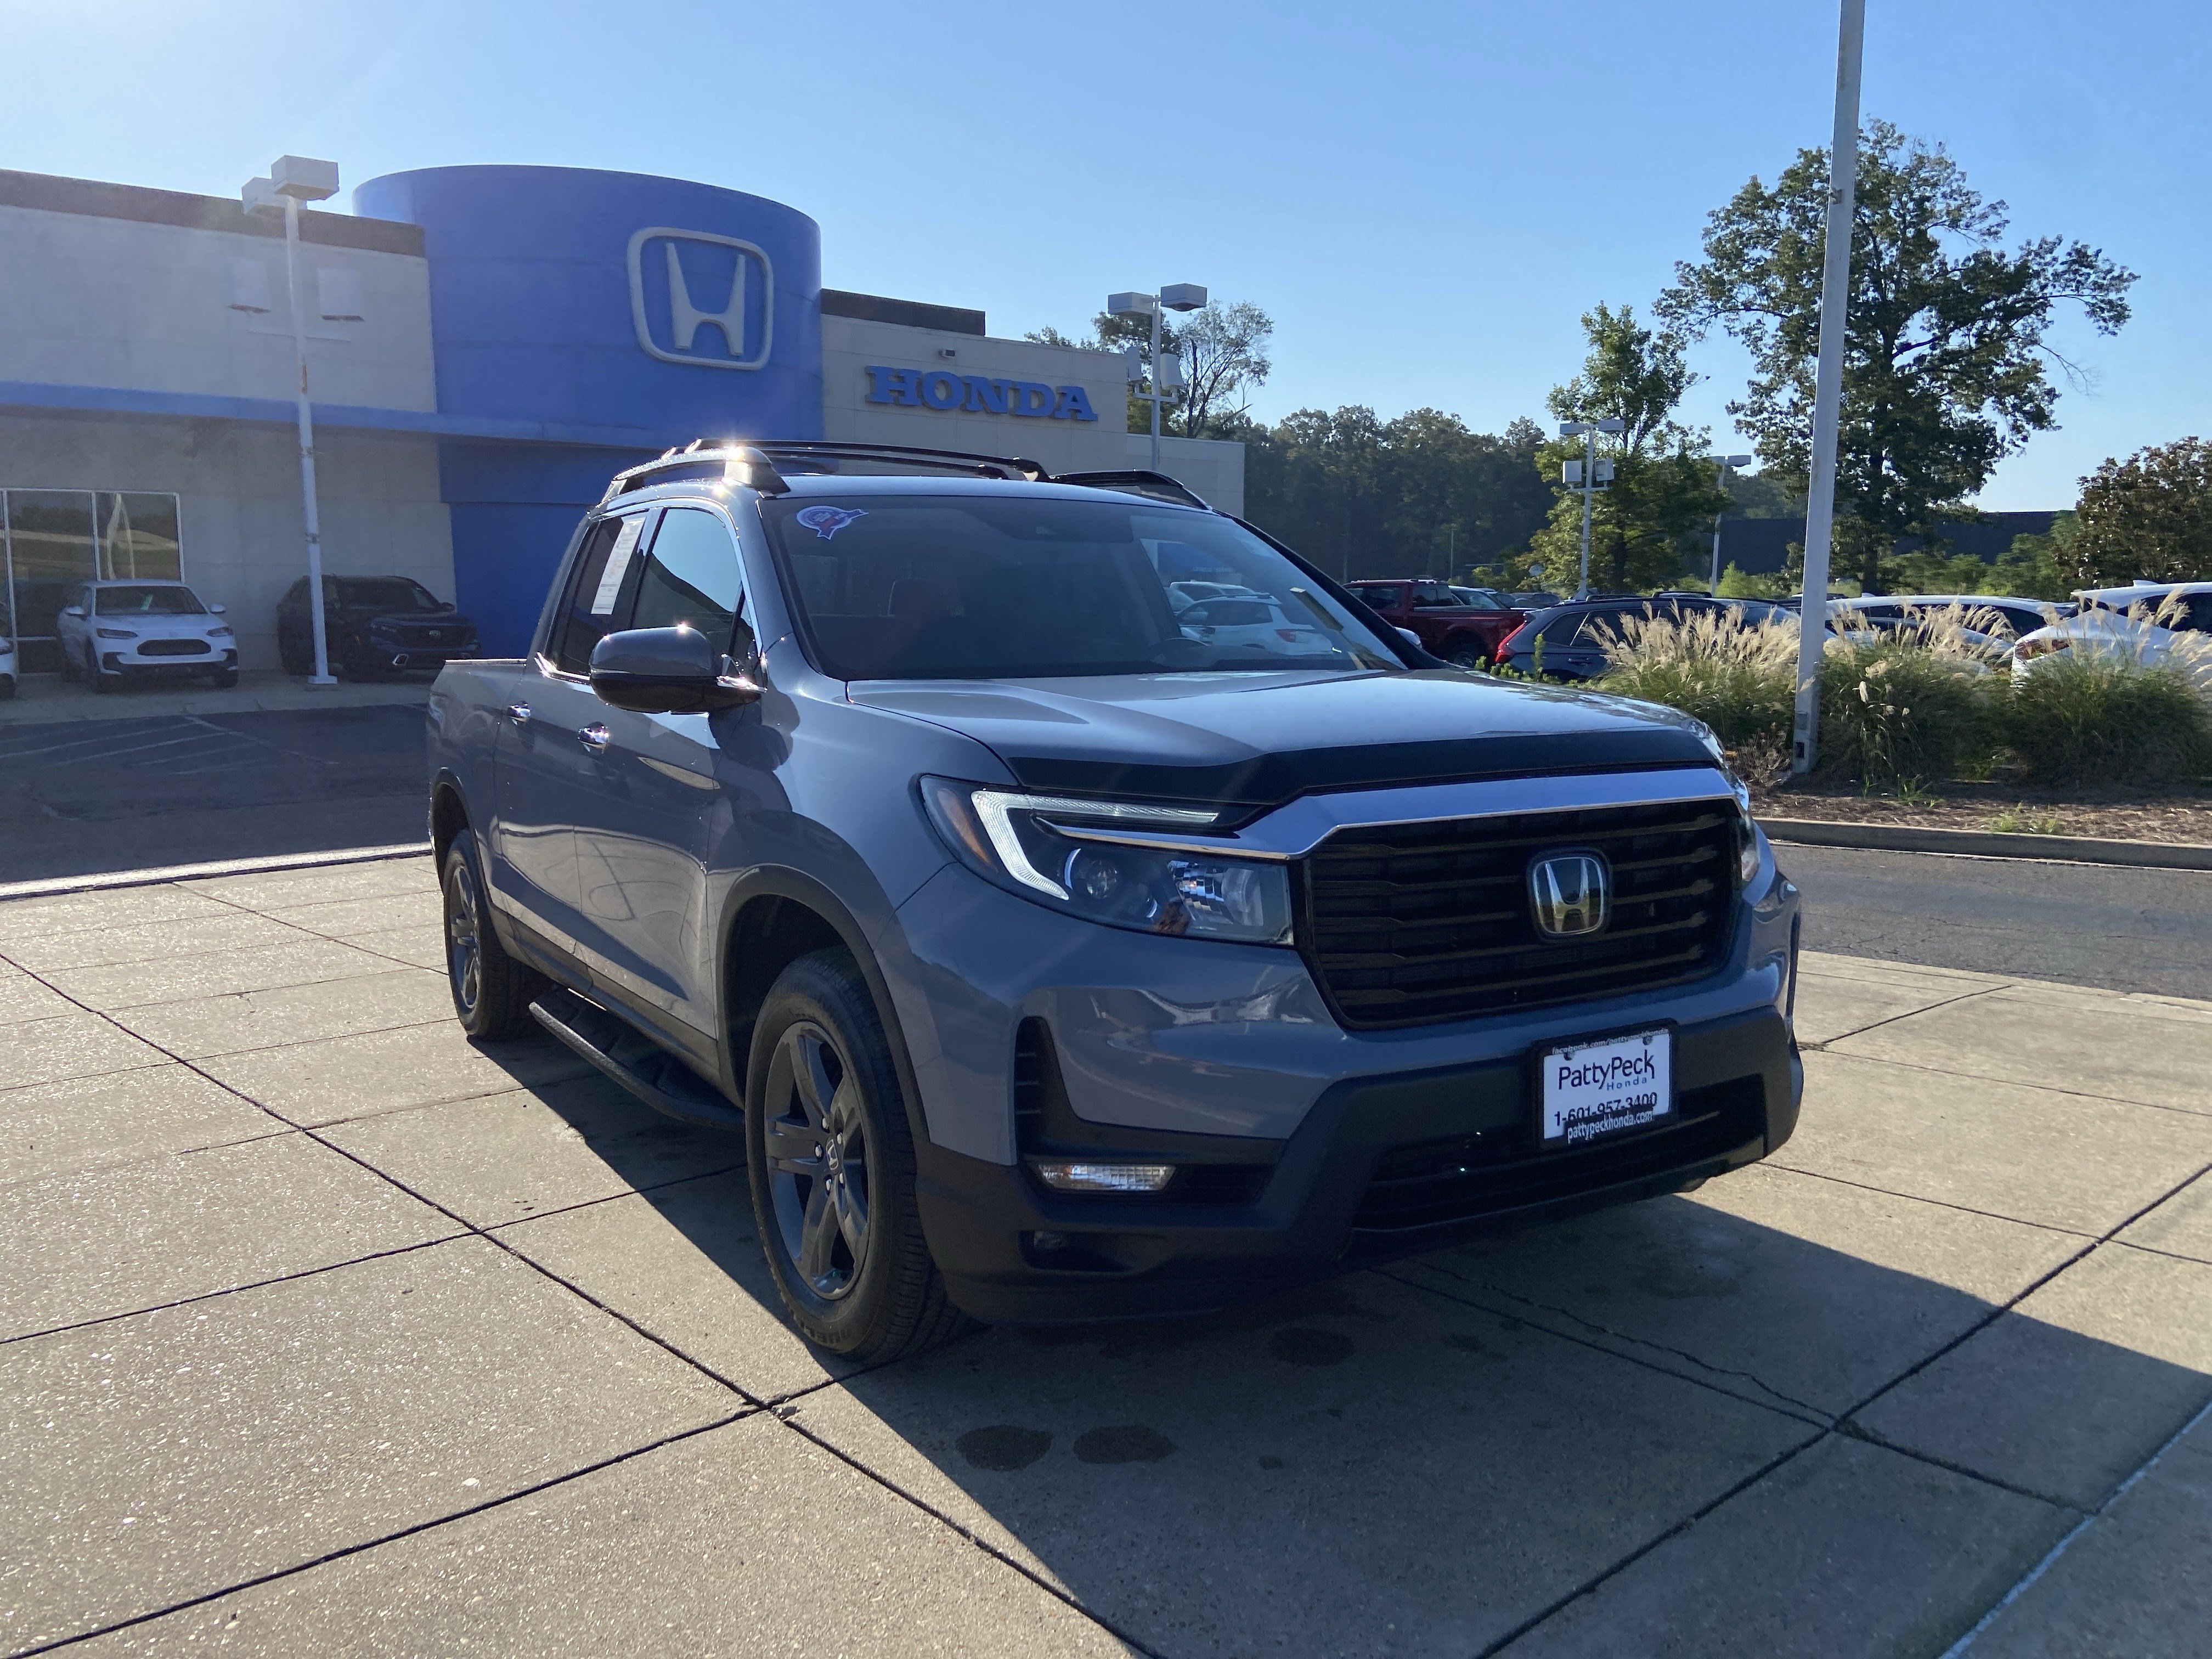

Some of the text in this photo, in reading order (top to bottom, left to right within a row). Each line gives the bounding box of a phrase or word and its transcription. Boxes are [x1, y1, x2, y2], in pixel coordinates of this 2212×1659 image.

[865, 365, 1098, 421] HONDA
[1559, 1049, 1654, 1090] PattyPeck
[1607, 1076, 1647, 1091] Honda
[1567, 1110, 1654, 1144] pattypeckhonda.com
